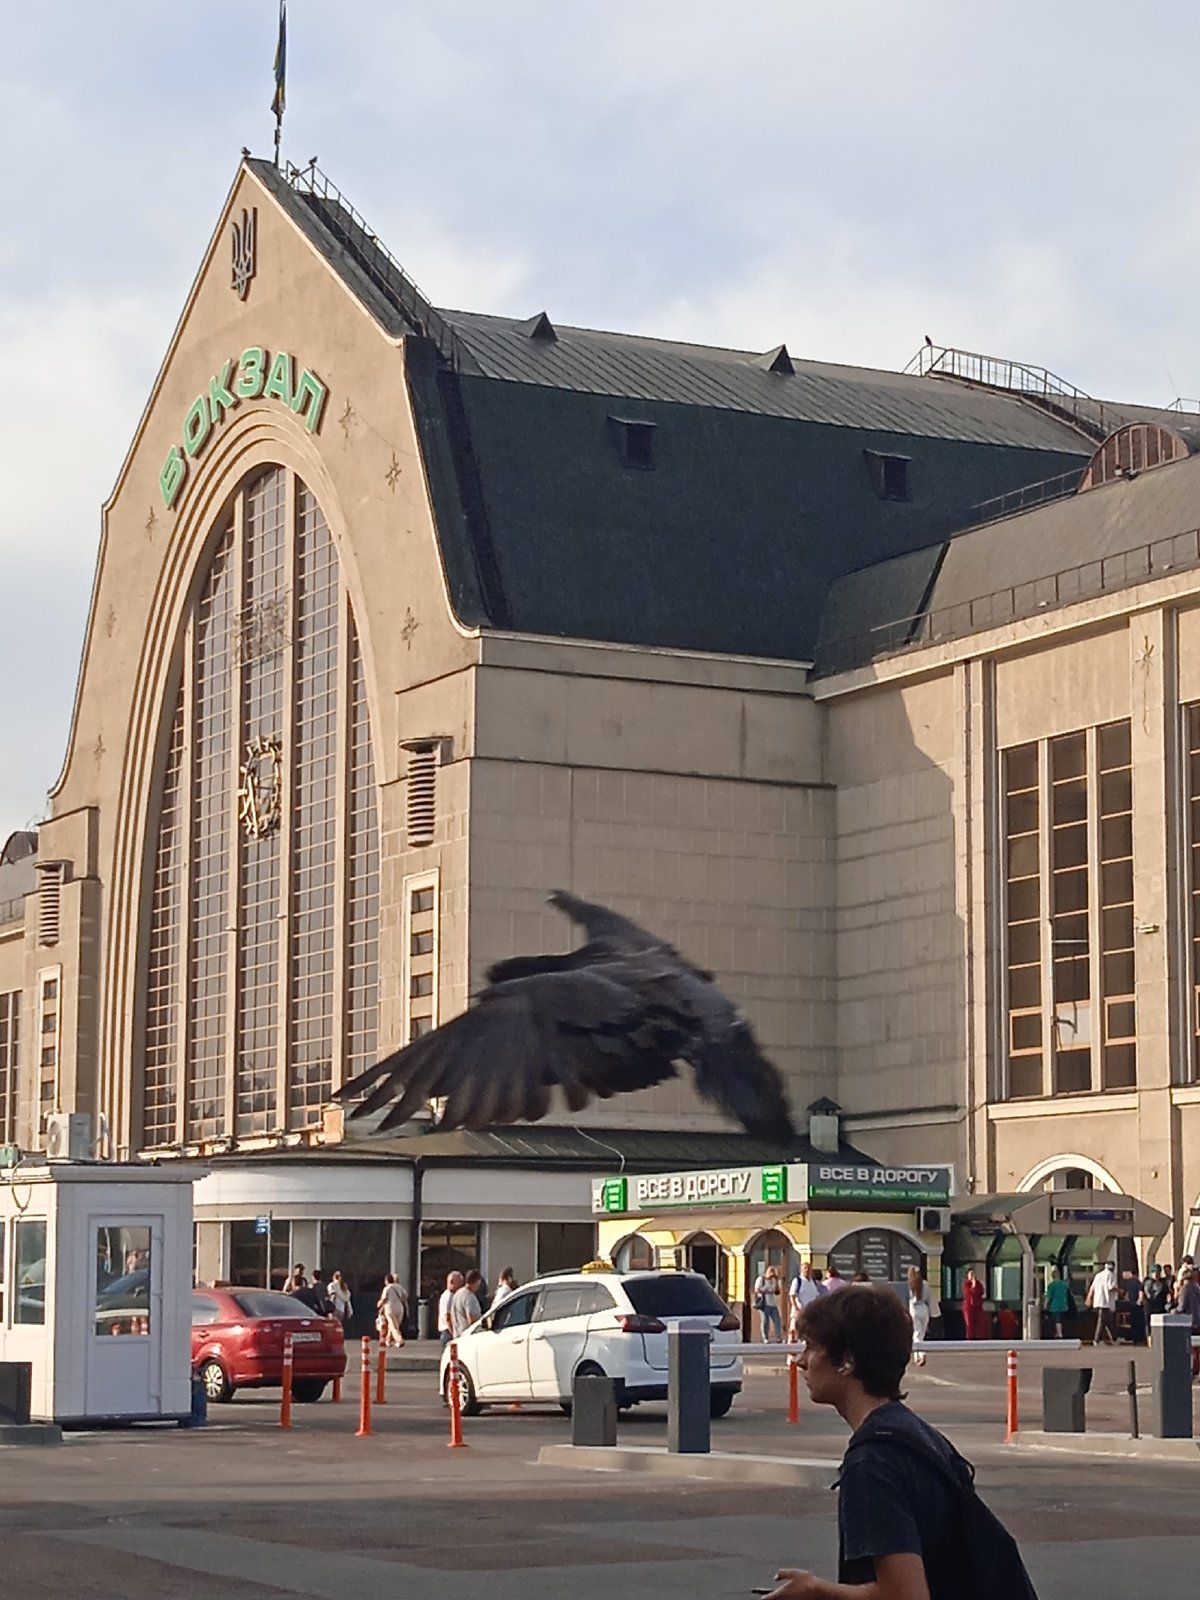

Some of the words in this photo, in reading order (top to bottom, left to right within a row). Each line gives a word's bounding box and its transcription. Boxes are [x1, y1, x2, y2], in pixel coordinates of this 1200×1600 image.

[160, 346, 326, 510] ВОКЗАЛ
[637, 1178, 668, 1199] ВСЕ
[671, 1176, 685, 1197] В
[686, 1172, 752, 1201] ДОРОГУ
[820, 1167, 854, 1180] ВСЕ
[857, 1168, 869, 1180] В
[872, 1169, 938, 1184] ДОРОГУ
